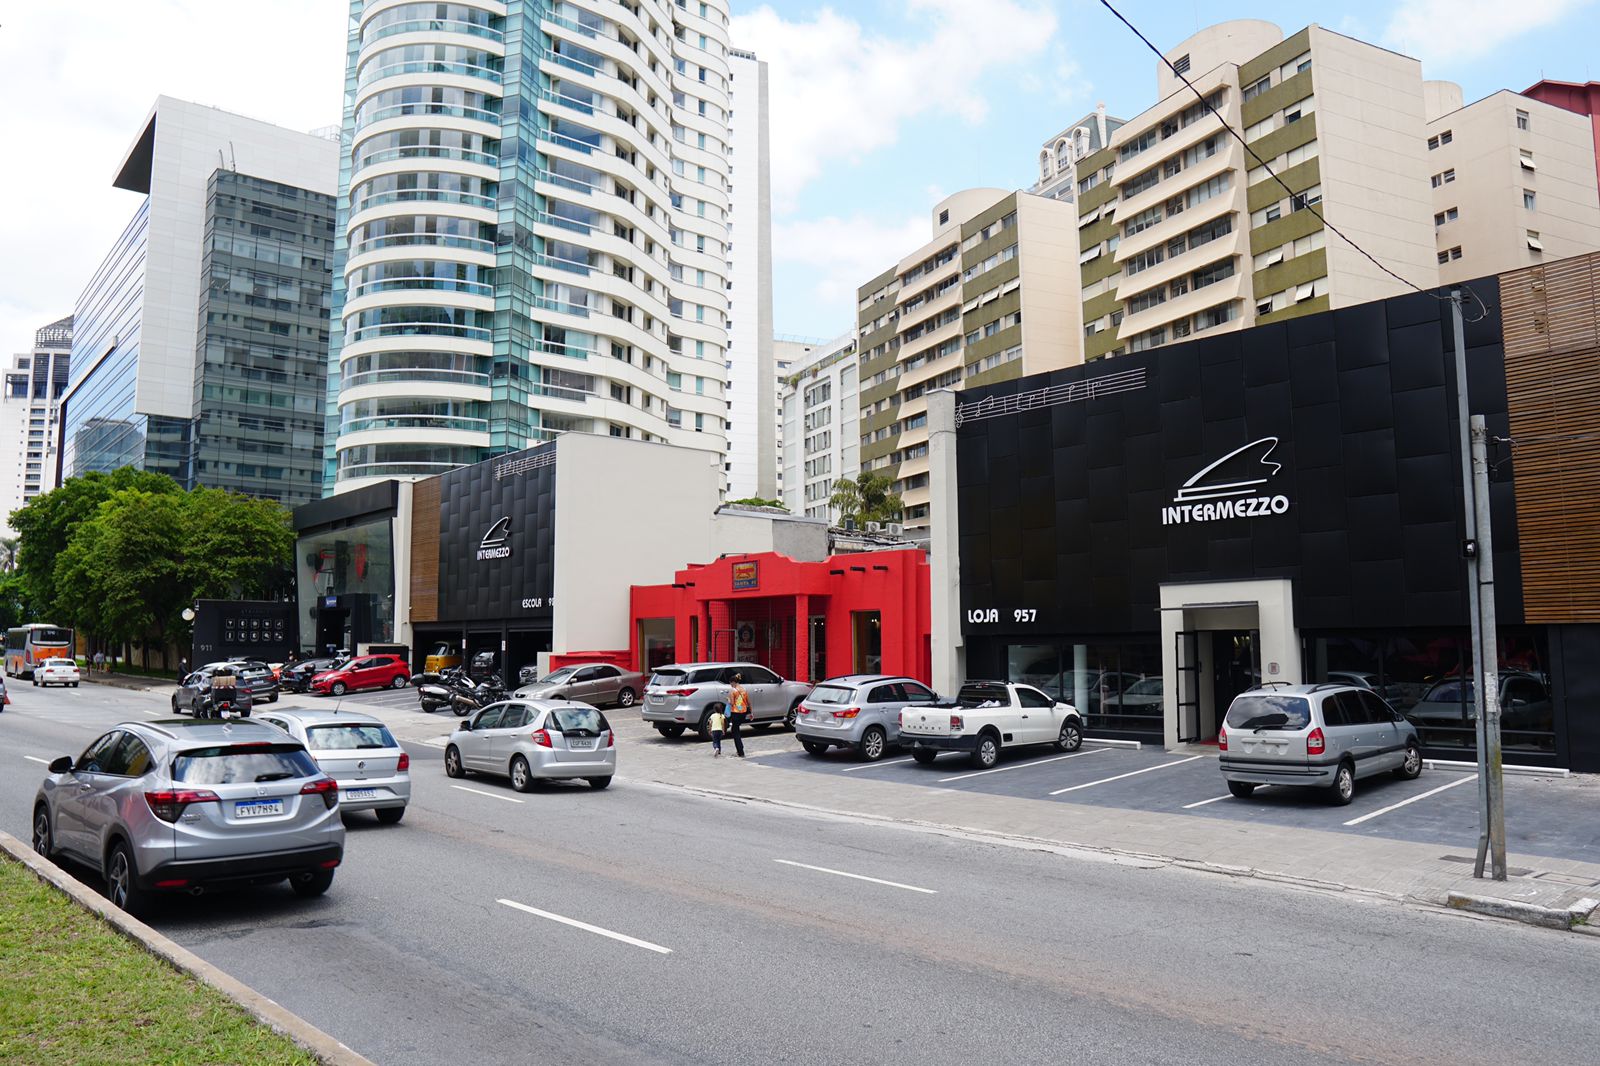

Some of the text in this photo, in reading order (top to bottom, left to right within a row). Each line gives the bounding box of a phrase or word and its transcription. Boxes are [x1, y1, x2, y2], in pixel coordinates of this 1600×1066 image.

[1162, 495, 1289, 525] INTERMEZZO
[476, 547, 510, 560] INTERMEZZO
[522, 598, 542, 608] ESCOLA
[967, 608, 1037, 623] LOJA 957
[200, 644, 213, 652] 911
